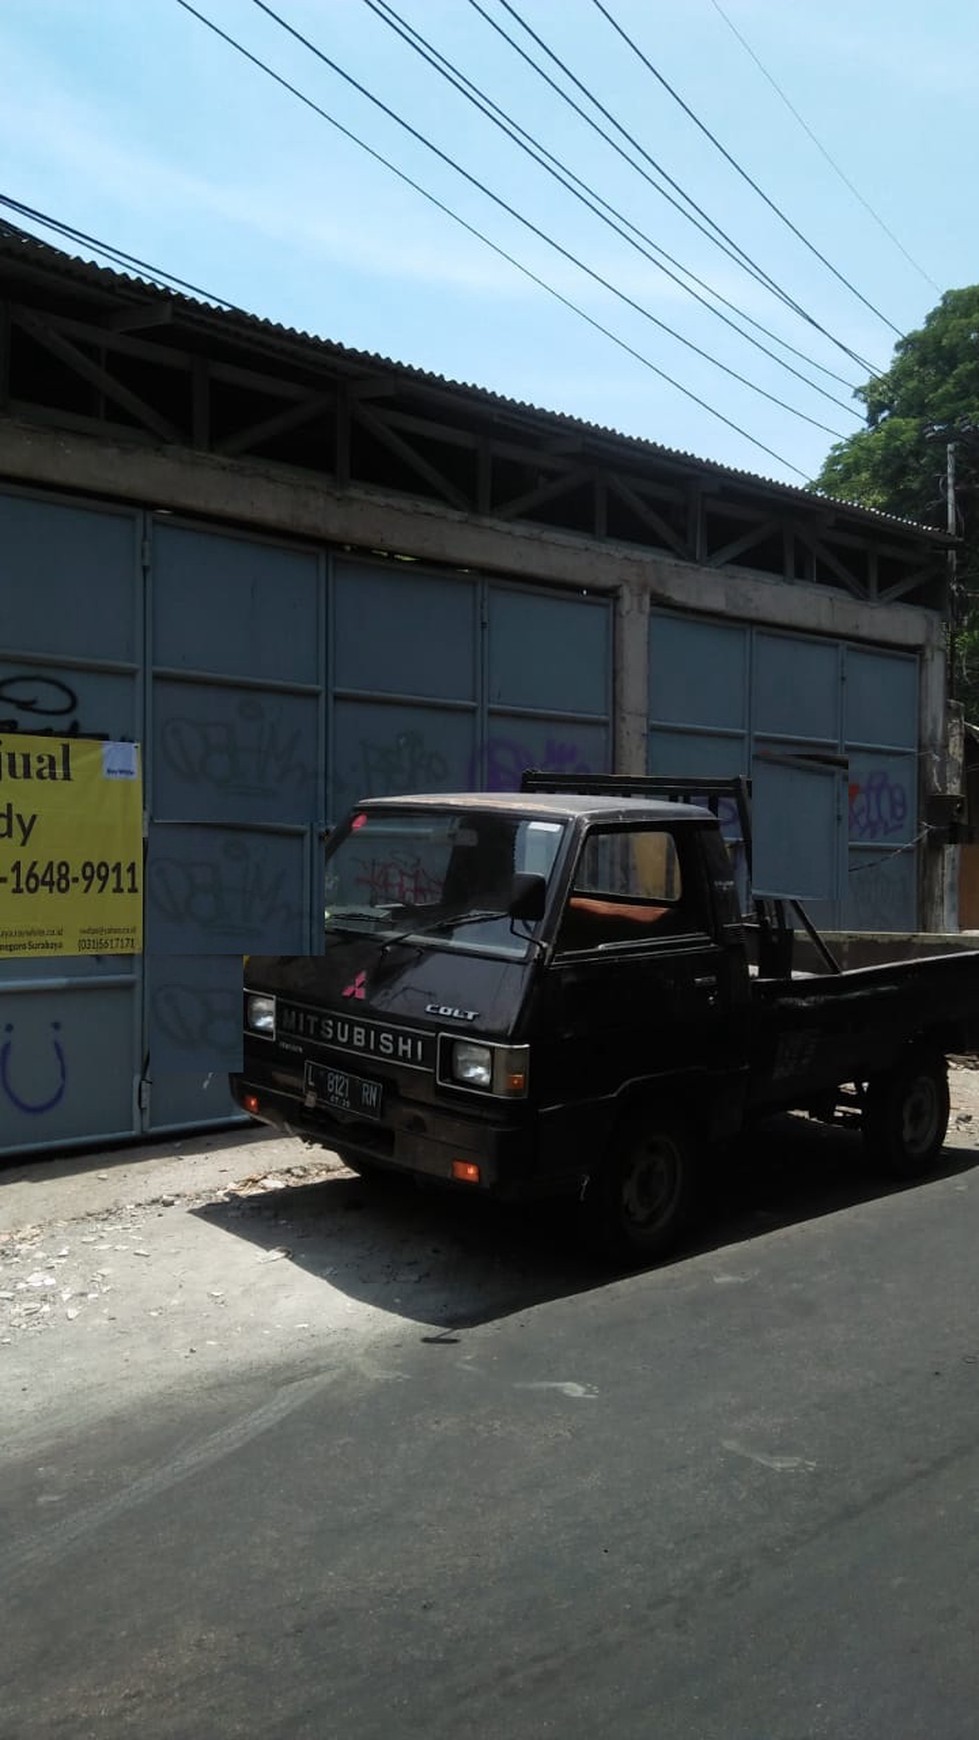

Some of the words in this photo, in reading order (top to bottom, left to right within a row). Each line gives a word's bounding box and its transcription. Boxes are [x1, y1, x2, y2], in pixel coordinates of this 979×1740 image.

[0, 740, 74, 782] ual
[425, 1003, 480, 1021] COLT
[281, 1009, 423, 1062] MITSUBISHI
[308, 1065, 315, 1087] L
[327, 1072, 350, 1098] 8121
